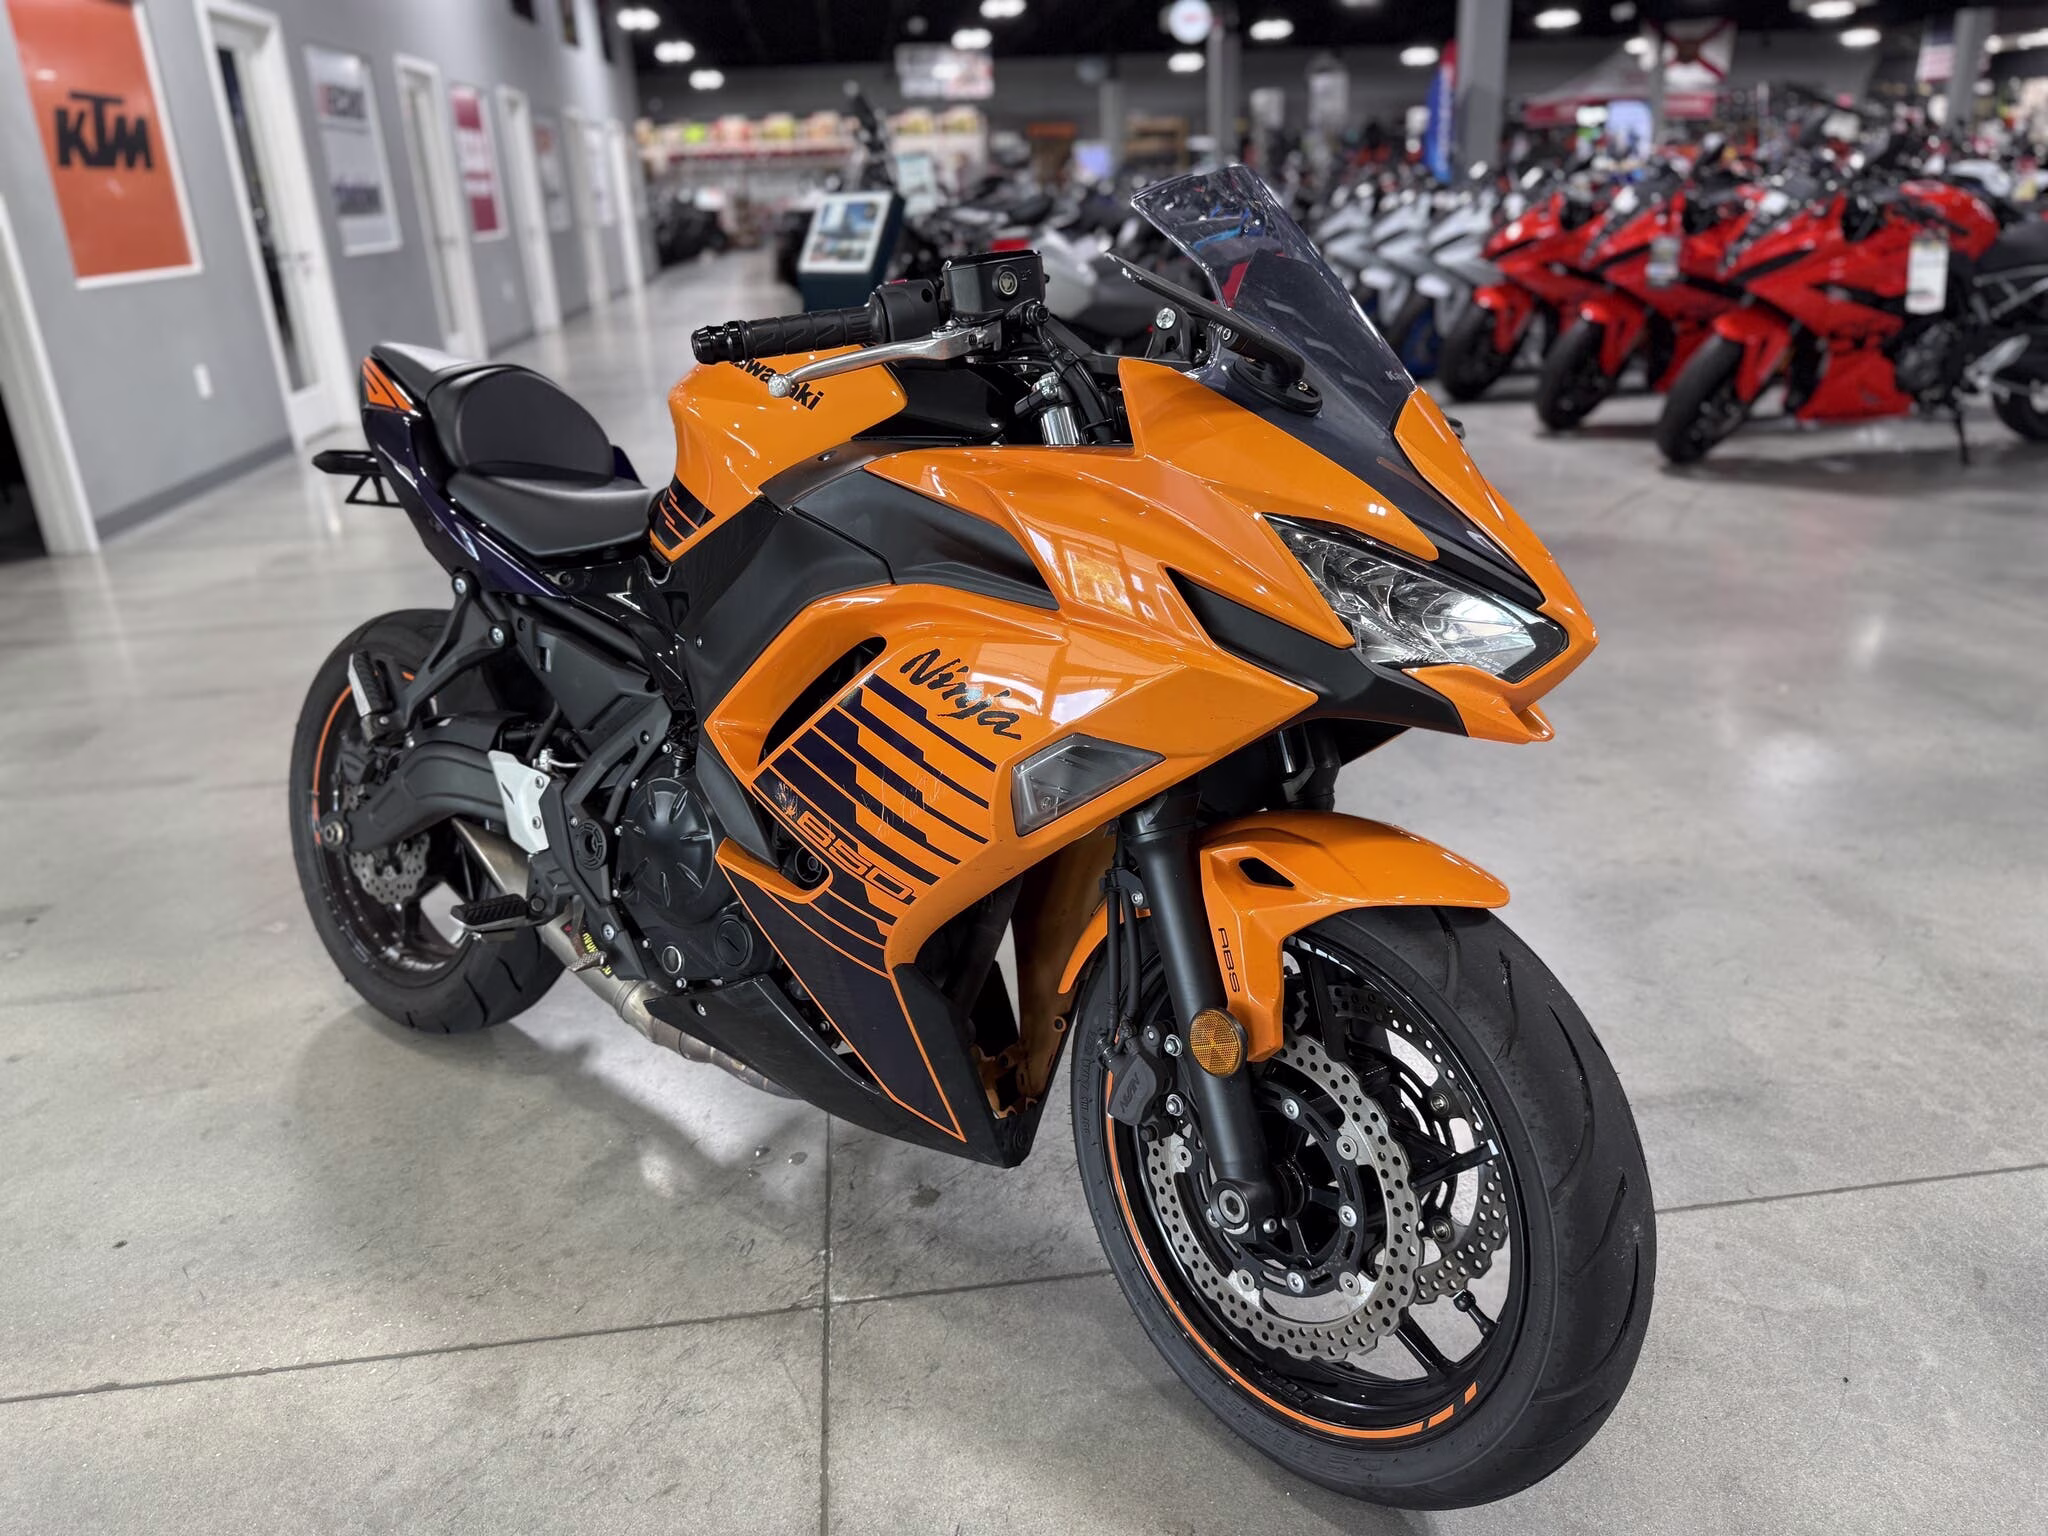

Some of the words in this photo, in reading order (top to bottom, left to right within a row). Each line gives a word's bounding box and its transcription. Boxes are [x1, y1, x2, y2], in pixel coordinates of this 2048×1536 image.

[55, 91, 153, 168] KTM
[899, 648, 1021, 740] Ninja
[797, 810, 914, 902] 650
[1218, 928, 1240, 992] ABS
